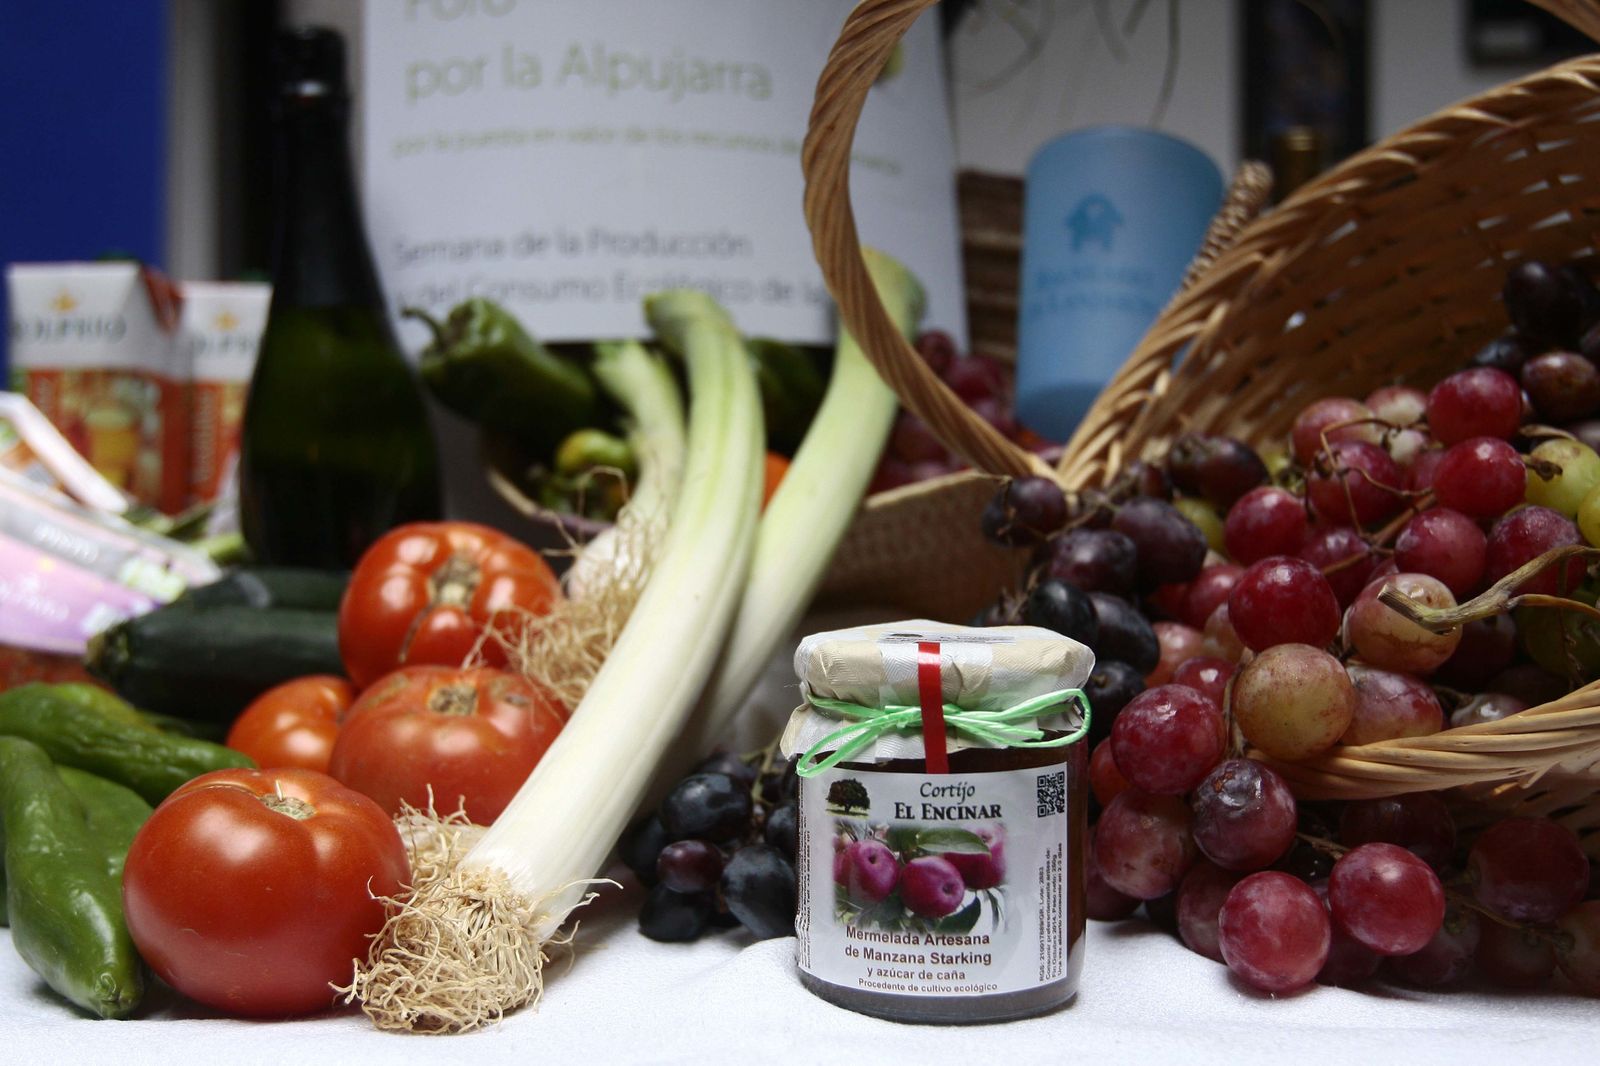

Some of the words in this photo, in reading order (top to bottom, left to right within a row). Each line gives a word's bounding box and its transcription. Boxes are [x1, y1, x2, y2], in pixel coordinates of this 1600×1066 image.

[405, 54, 489, 104] por
[502, 41, 543, 91] la
[555, 39, 774, 102] Alpujarra
[397, 235, 503, 268] Semana
[513, 228, 549, 259] de
[554, 228, 583, 257] la
[588, 223, 753, 259] Producción
[920, 782, 976, 804] Cortijo
[894, 801, 916, 820] EL
[920, 802, 1003, 821] ENCINAR
[845, 925, 921, 945] Mermelada
[924, 933, 991, 946] Artesana
[844, 944, 860, 958] de
[863, 946, 926, 964] Manzana
[929, 951, 992, 966] Starking
[867, 967, 874, 978] y
[876, 967, 915, 980] azúcar
[918, 969, 934, 980] de
[936, 969, 966, 981] caña
[857, 977, 906, 991] Procedente
[907, 983, 919, 992] de
[921, 984, 952, 993] cultivo
[953, 983, 998, 994] ecológico
